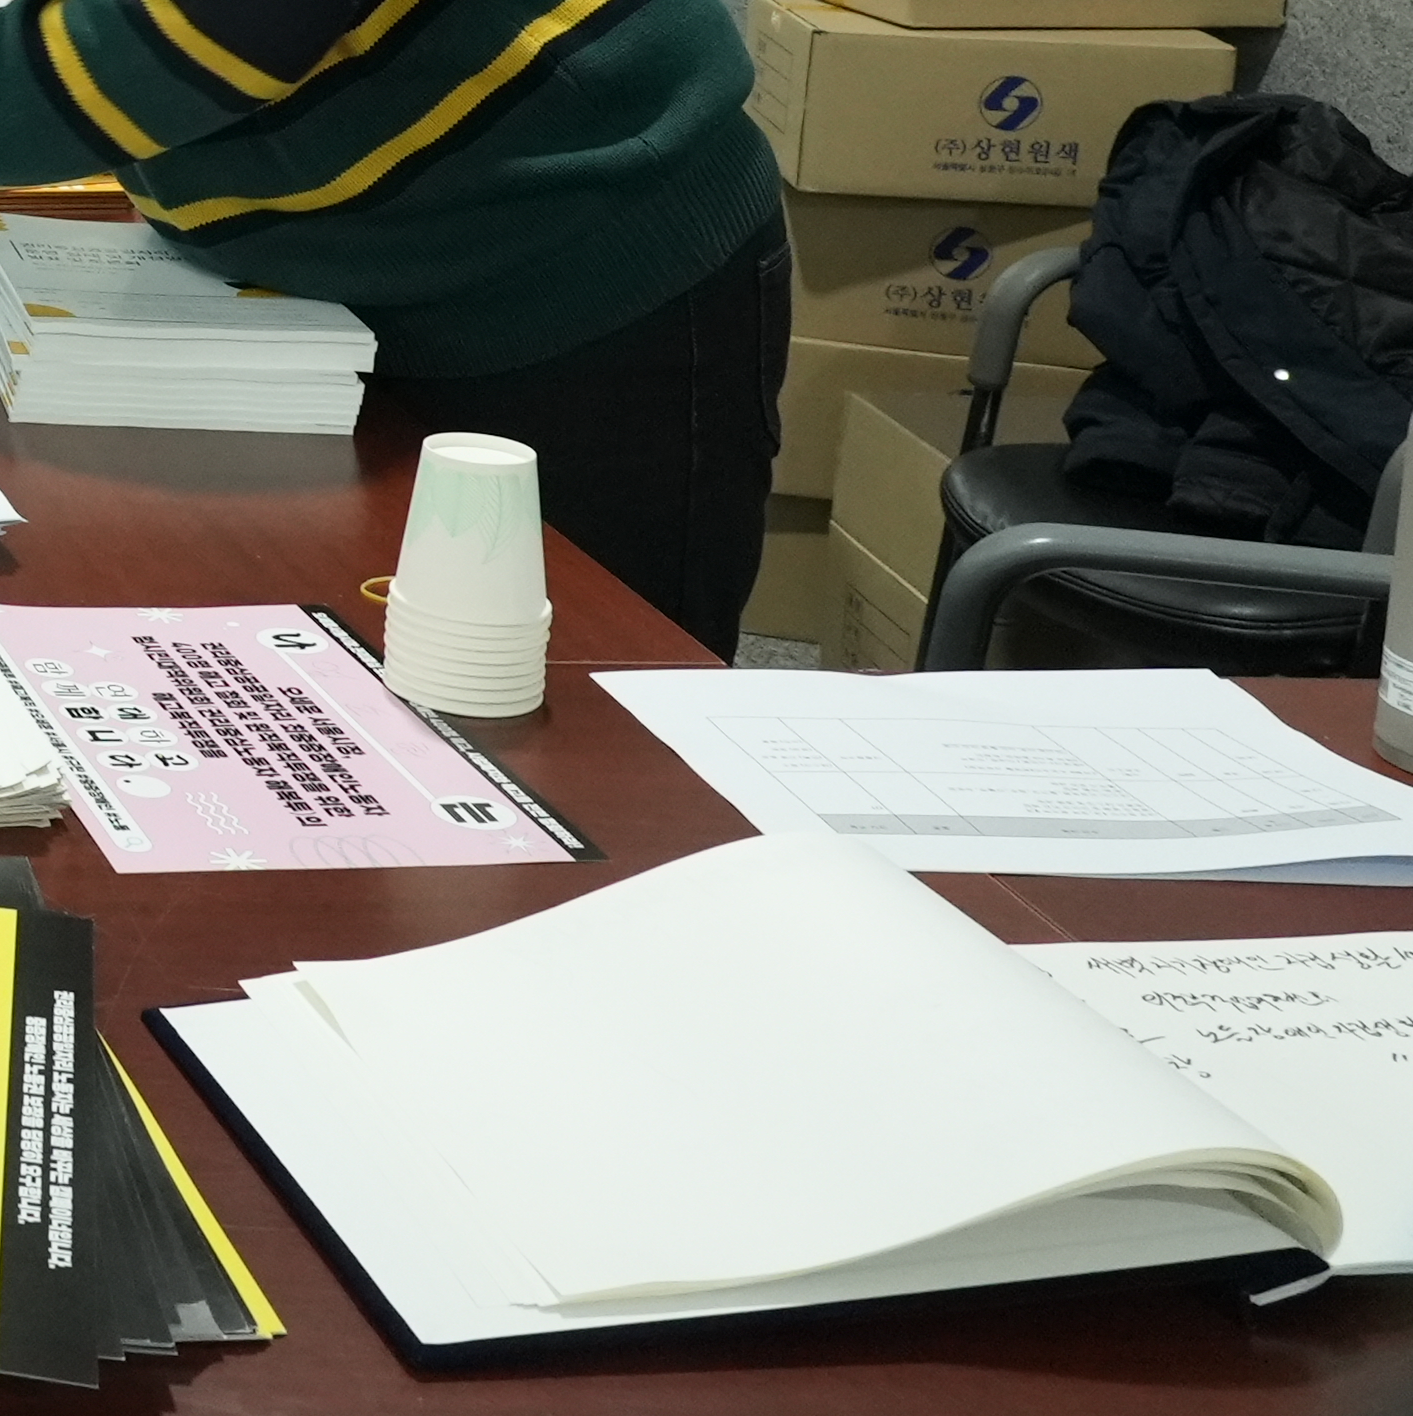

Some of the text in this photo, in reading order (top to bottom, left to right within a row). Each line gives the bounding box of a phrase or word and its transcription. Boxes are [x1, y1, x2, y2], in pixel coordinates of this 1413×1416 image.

[171, 641, 212, 668] 400명
[197, 670, 230, 688] 해고
[213, 689, 251, 709] 철회
[151, 691, 229, 760] 해고복직투쟁을
[200, 642, 291, 721] 권리중심공공일자리
[280, 723, 387, 815] 최중증장애인노동자
[277, 686, 323, 714] 오세훈
[309, 716, 364, 758] 서울시장,
[245, 722, 330, 792] 원직복직투쟁을
[314, 795, 355, 818] 위한
